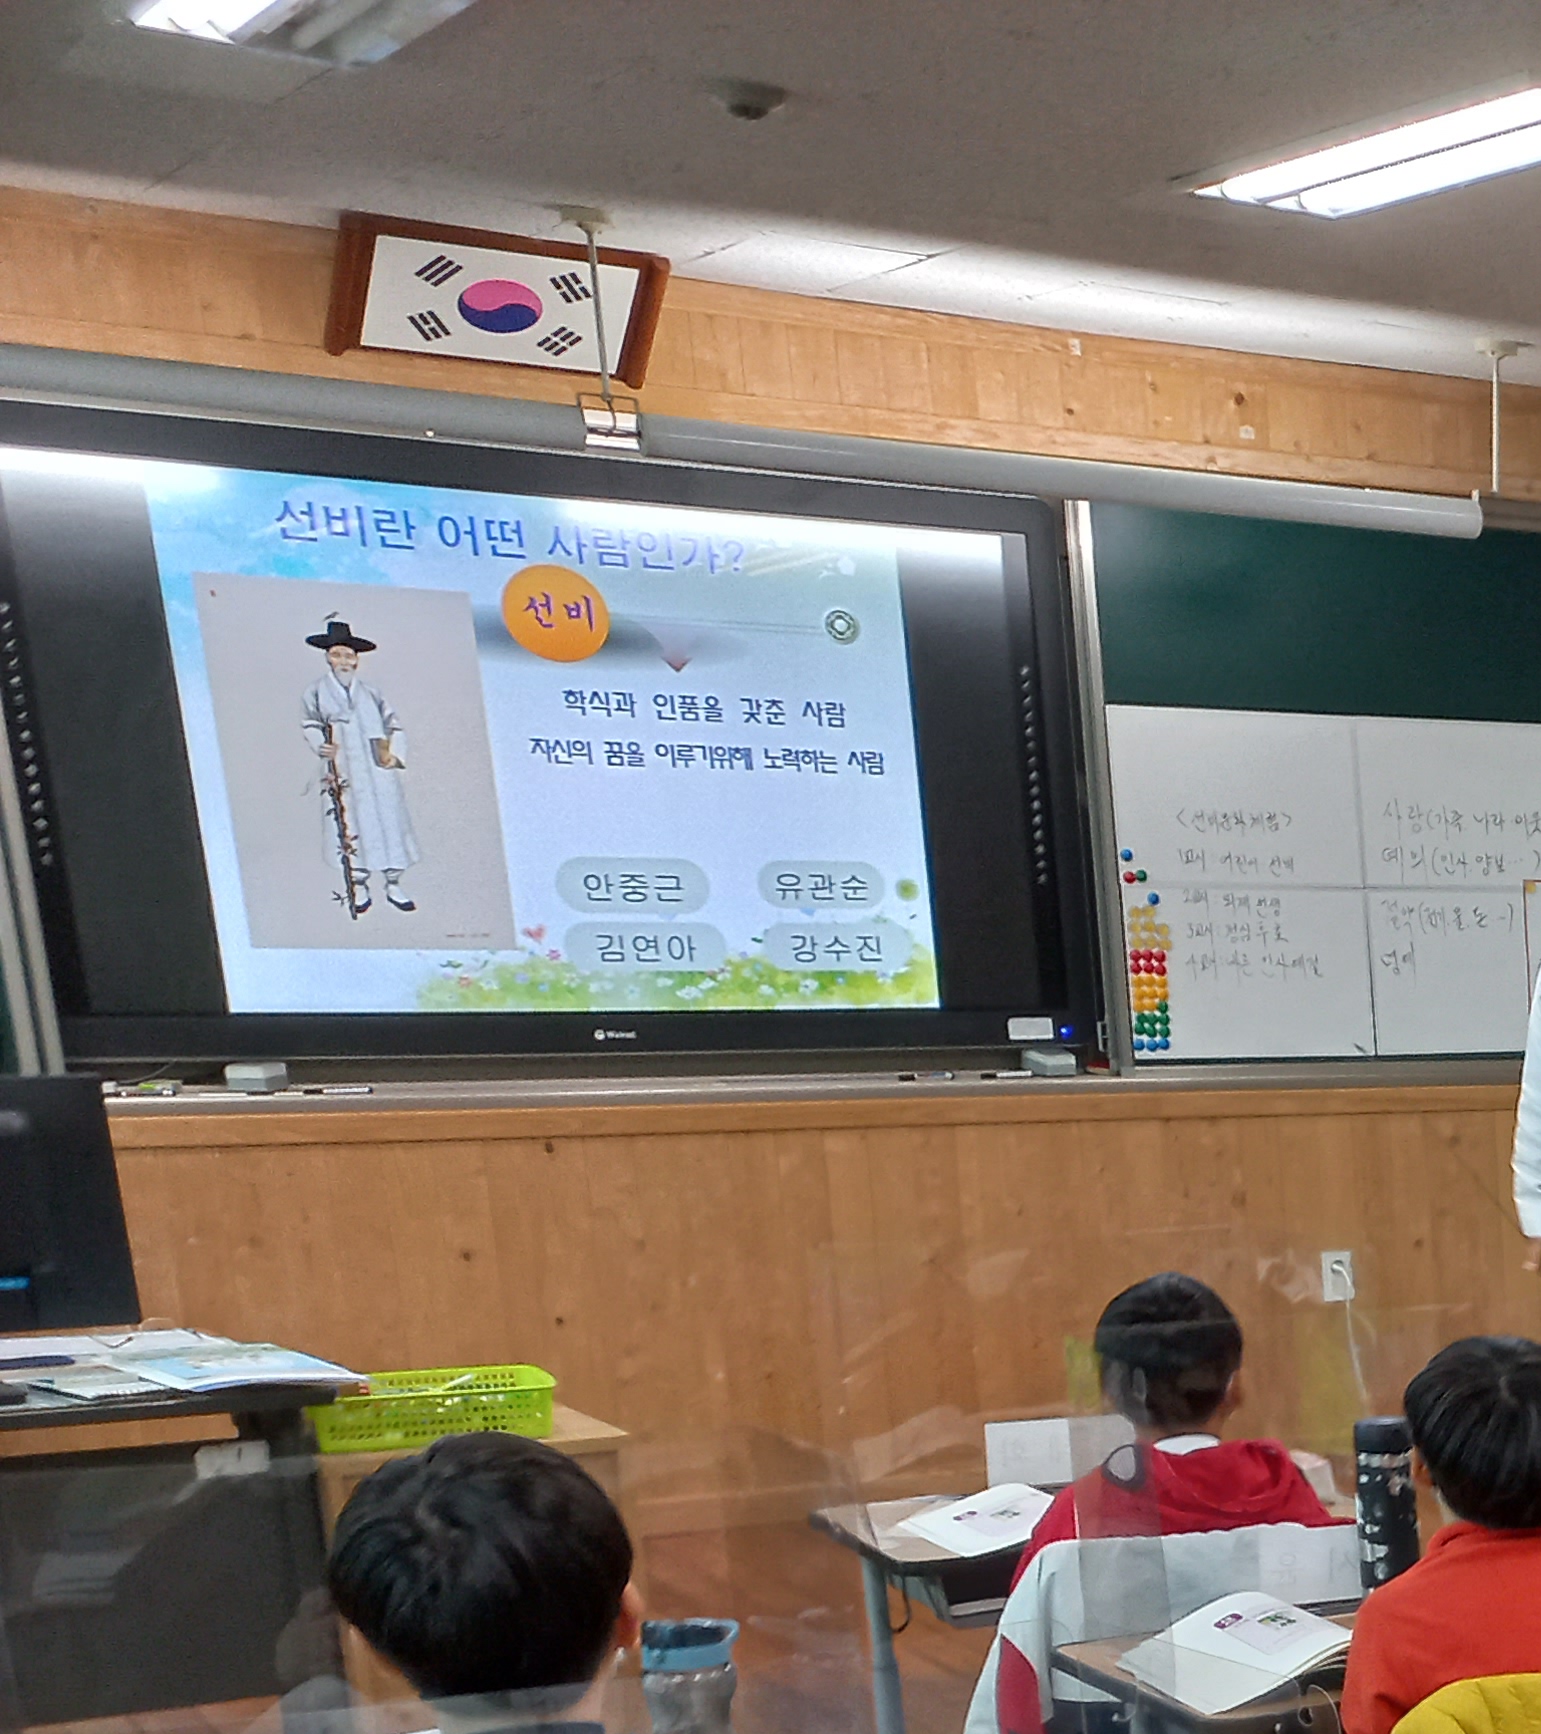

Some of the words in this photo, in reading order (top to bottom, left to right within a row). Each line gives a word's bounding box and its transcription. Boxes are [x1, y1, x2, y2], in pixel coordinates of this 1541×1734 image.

[275, 499, 416, 551] 선비란
[438, 514, 527, 560] 어떤
[547, 522, 746, 575] 사람인가?
[522, 591, 596, 632] 선비
[562, 689, 637, 718] 학식과
[652, 694, 724, 723] 인품을
[739, 697, 786, 726] 갖춘
[802, 700, 847, 728] 사람
[529, 737, 593, 766] 자신의
[603, 740, 646, 768] 꿈을
[655, 742, 754, 771] 이루기위해
[763, 747, 838, 775] 노력하는
[847, 750, 885, 776] 사람
[583, 872, 684, 902] 안중근
[775, 872, 869, 901] 유관순
[596, 934, 697, 963] 김연아
[791, 934, 883, 963] 강수진
